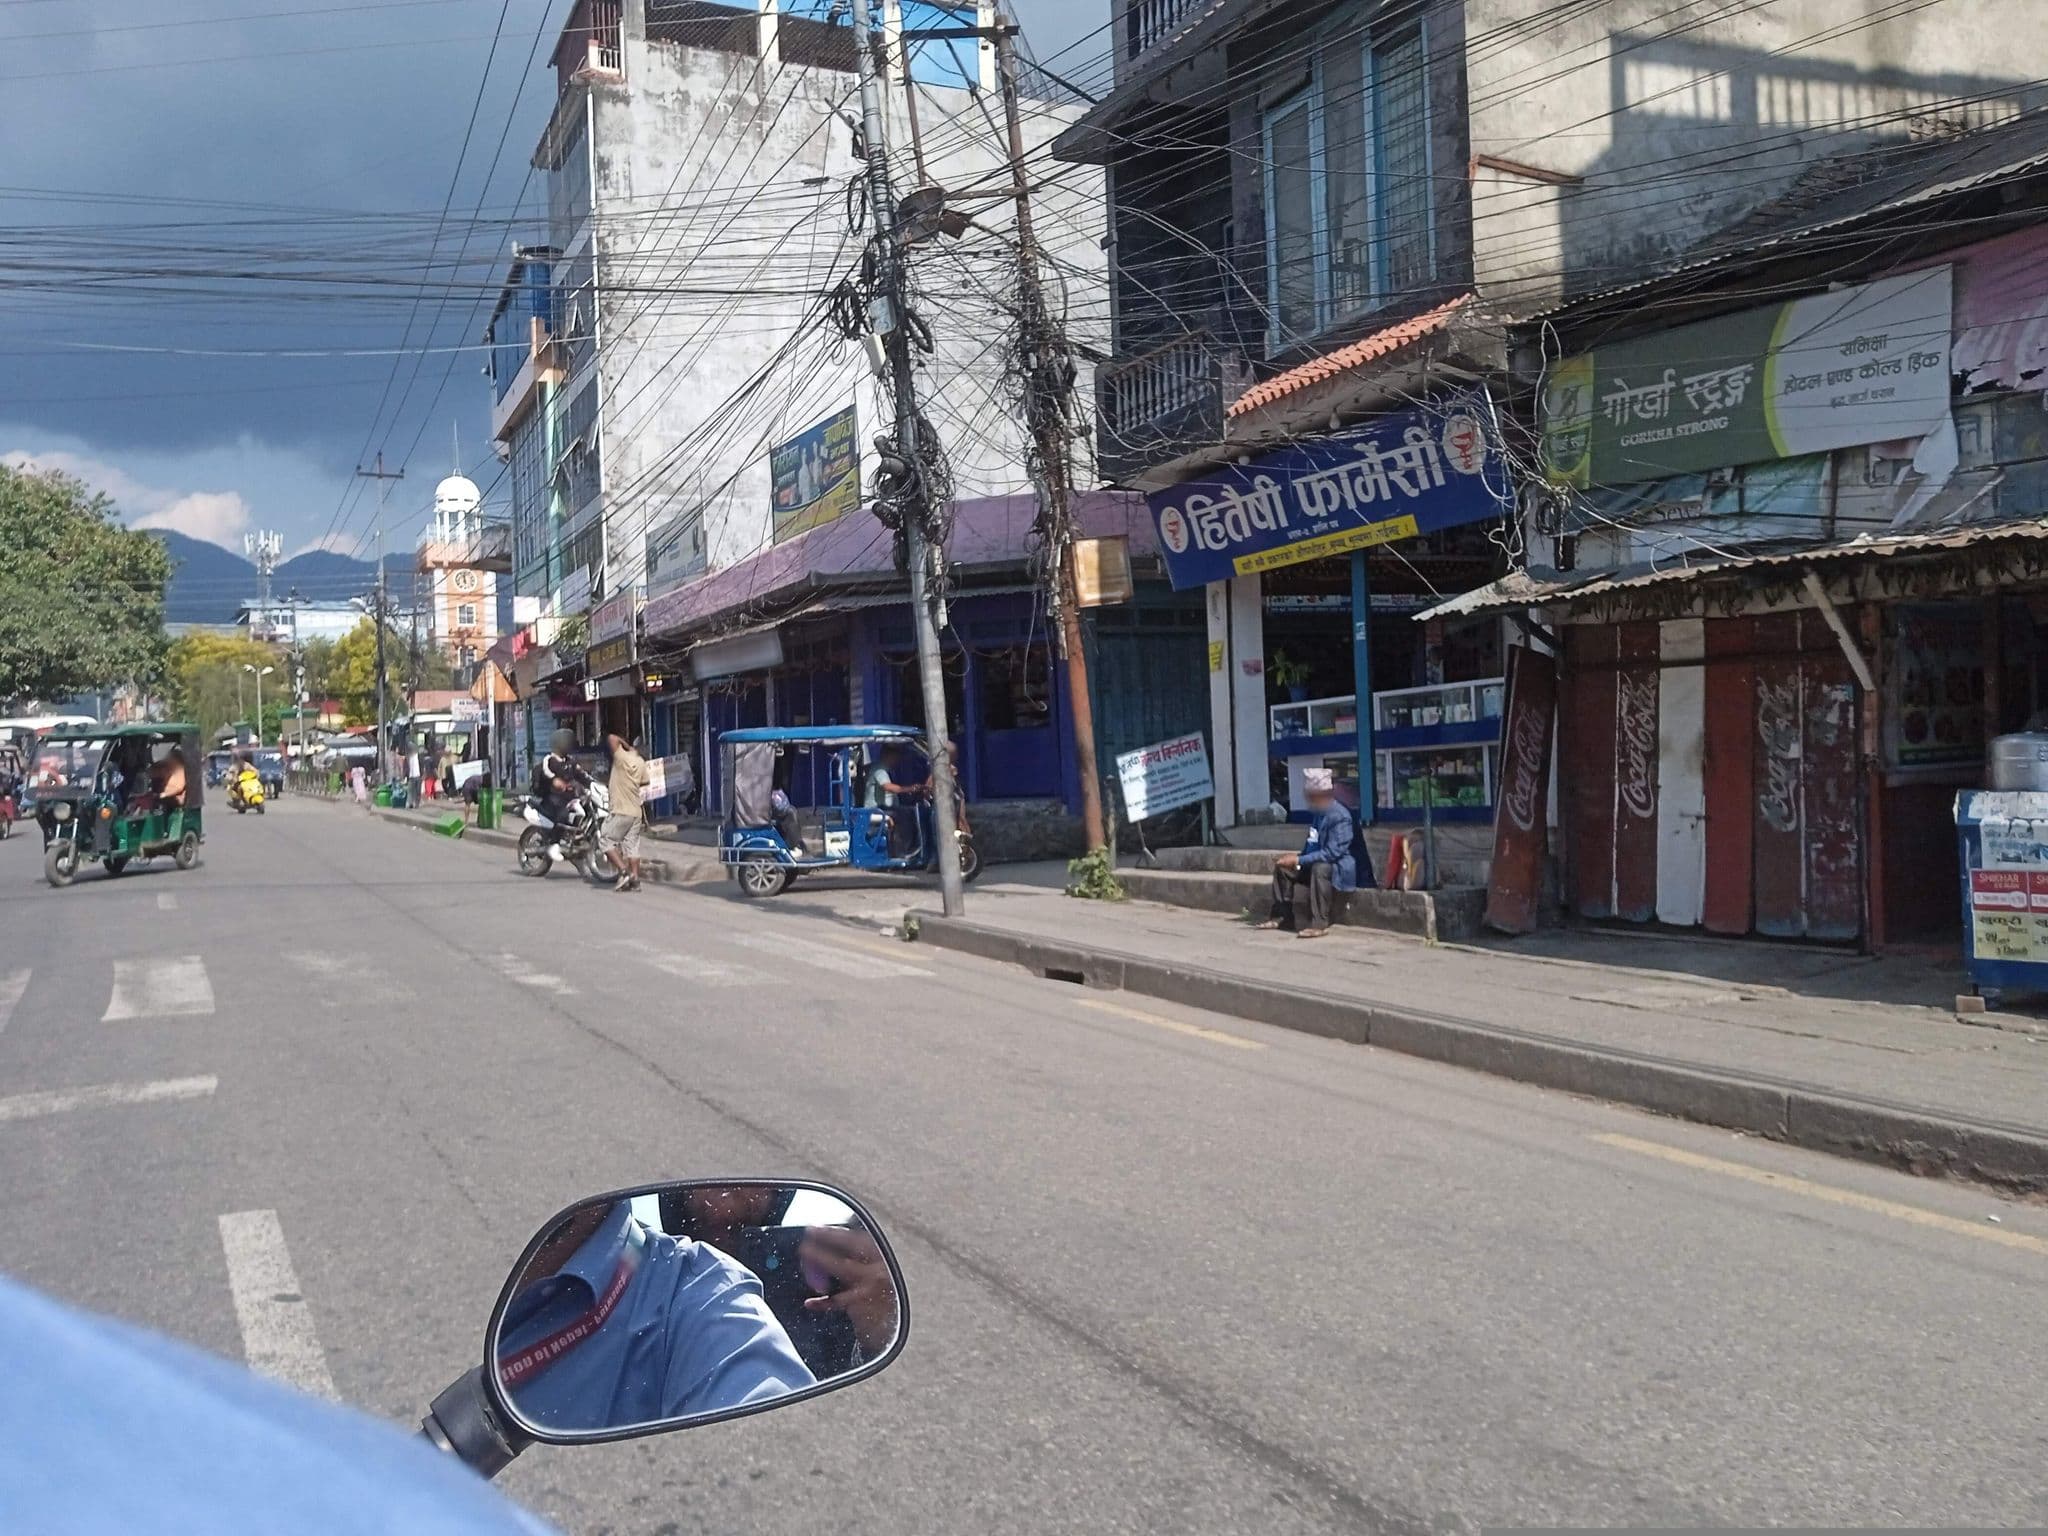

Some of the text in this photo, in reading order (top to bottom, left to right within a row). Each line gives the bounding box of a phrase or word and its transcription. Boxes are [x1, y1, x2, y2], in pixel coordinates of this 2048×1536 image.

[1602, 368, 1677, 427] गोर्खा
[1783, 374, 1821, 396] होटल
[1621, 415, 1729, 448] GORKHA STRONG
[1186, 474, 1289, 551] हितैषी
